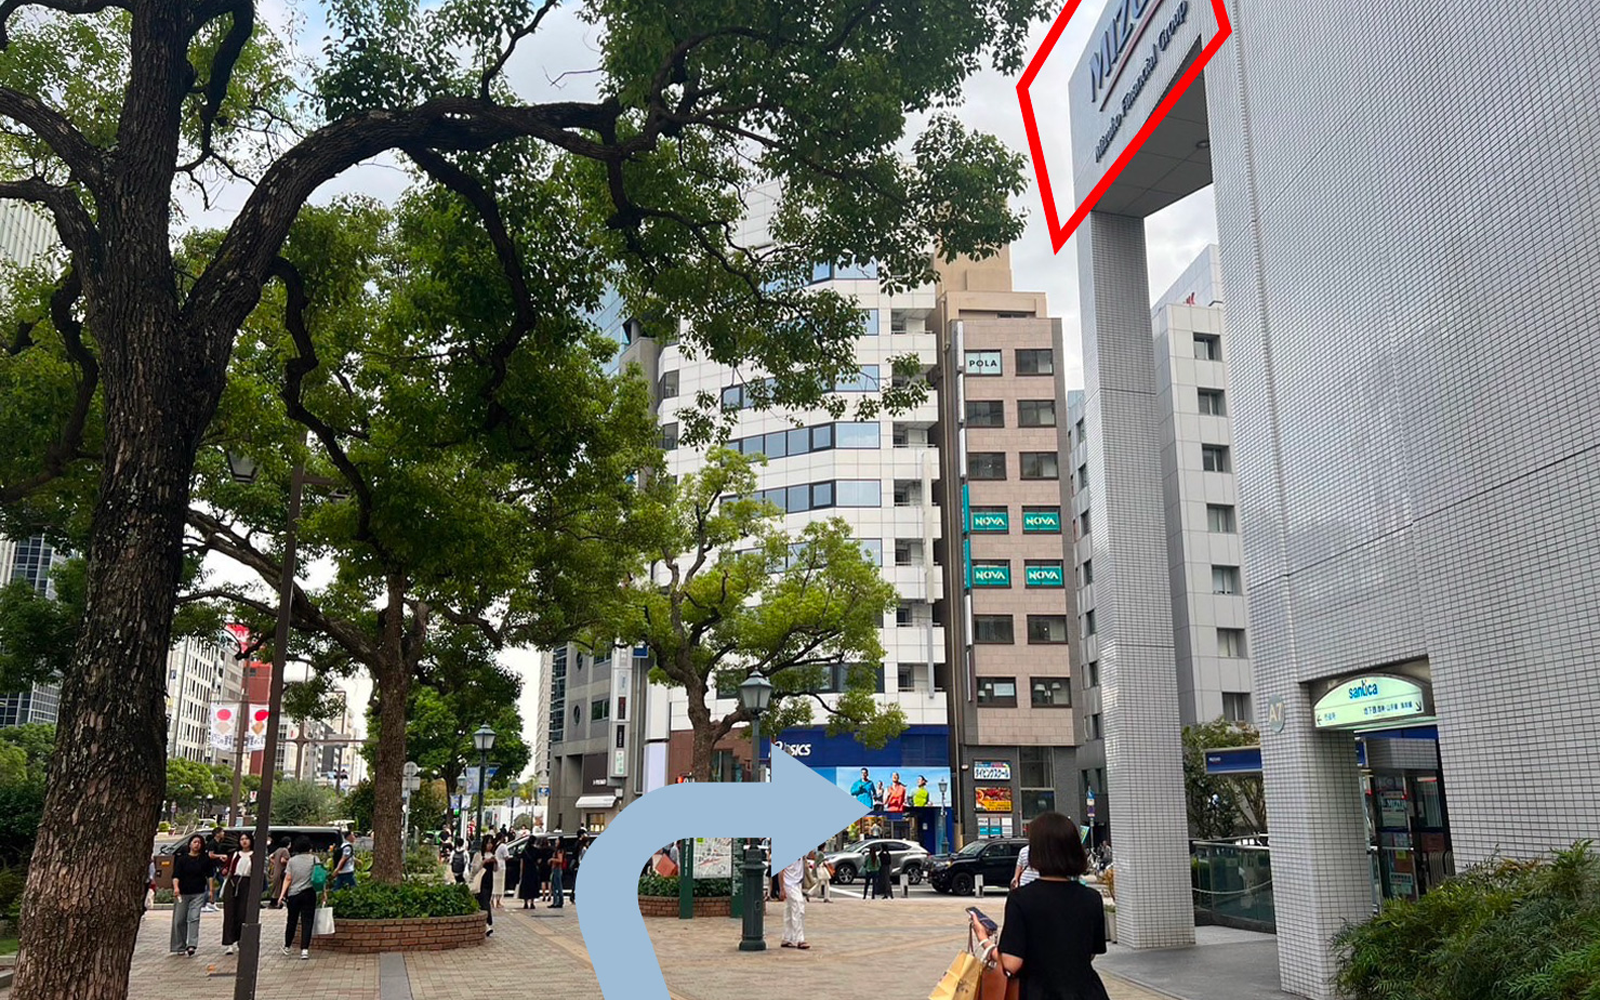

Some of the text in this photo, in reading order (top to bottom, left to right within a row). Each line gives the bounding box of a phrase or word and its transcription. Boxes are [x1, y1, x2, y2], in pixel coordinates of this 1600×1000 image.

[1122, 43, 1158, 118] Financial
[1158, 0, 1188, 52] Group
[969, 359, 998, 367] POLA
[974, 516, 1005, 526] NOVA
[1025, 516, 1056, 526] NOVA
[975, 570, 1006, 580] NOVA
[1028, 570, 1059, 580] NOVA
[1348, 679, 1378, 699] santica
[1268, 701, 1284, 722] A7
